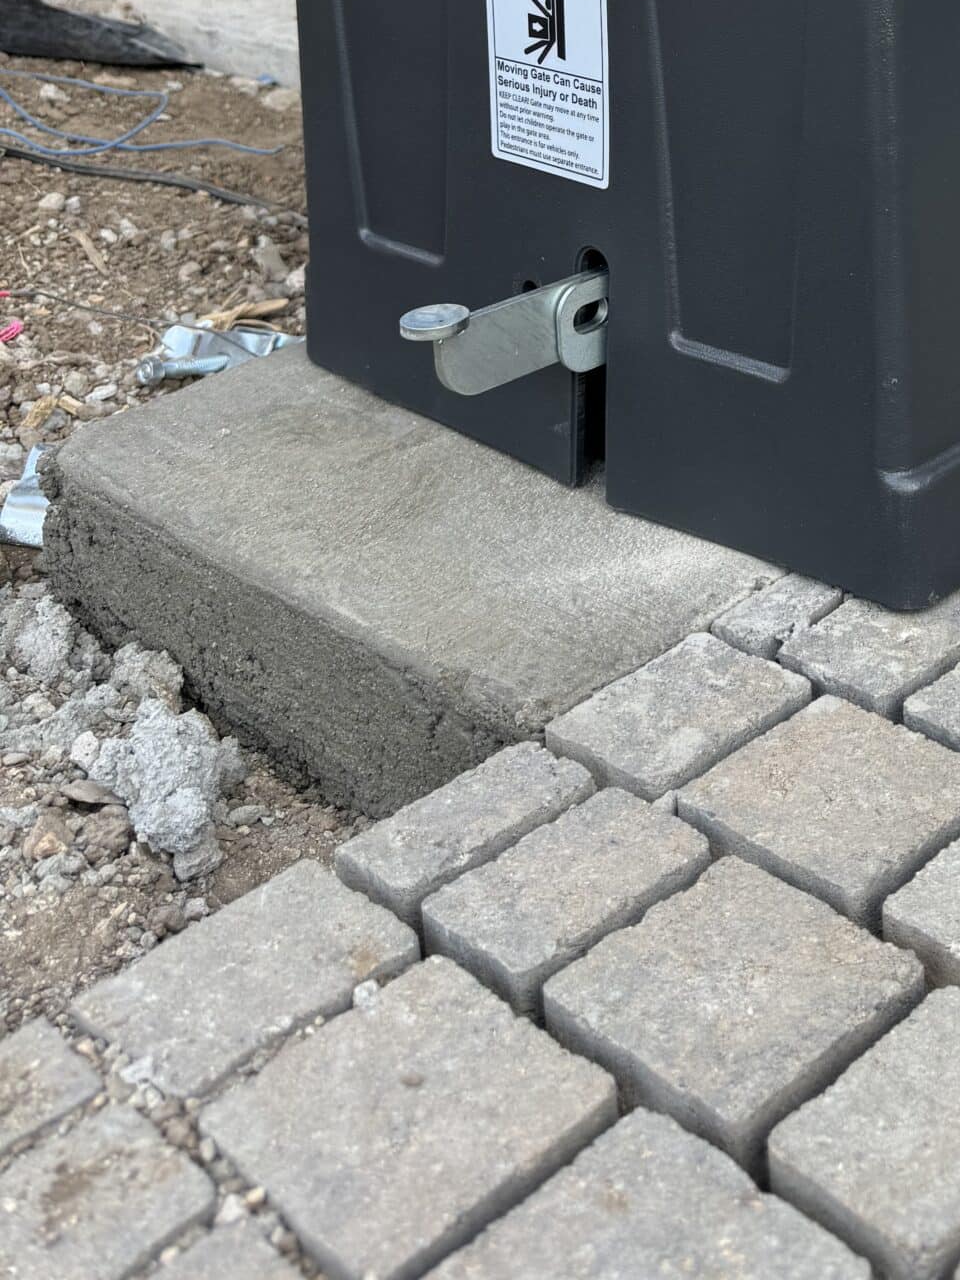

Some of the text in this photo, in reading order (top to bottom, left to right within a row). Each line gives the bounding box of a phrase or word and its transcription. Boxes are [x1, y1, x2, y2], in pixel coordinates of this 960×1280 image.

[497, 60, 601, 95] Moving Gate Can Cause
[498, 75, 597, 110] Serious Injury or Death
